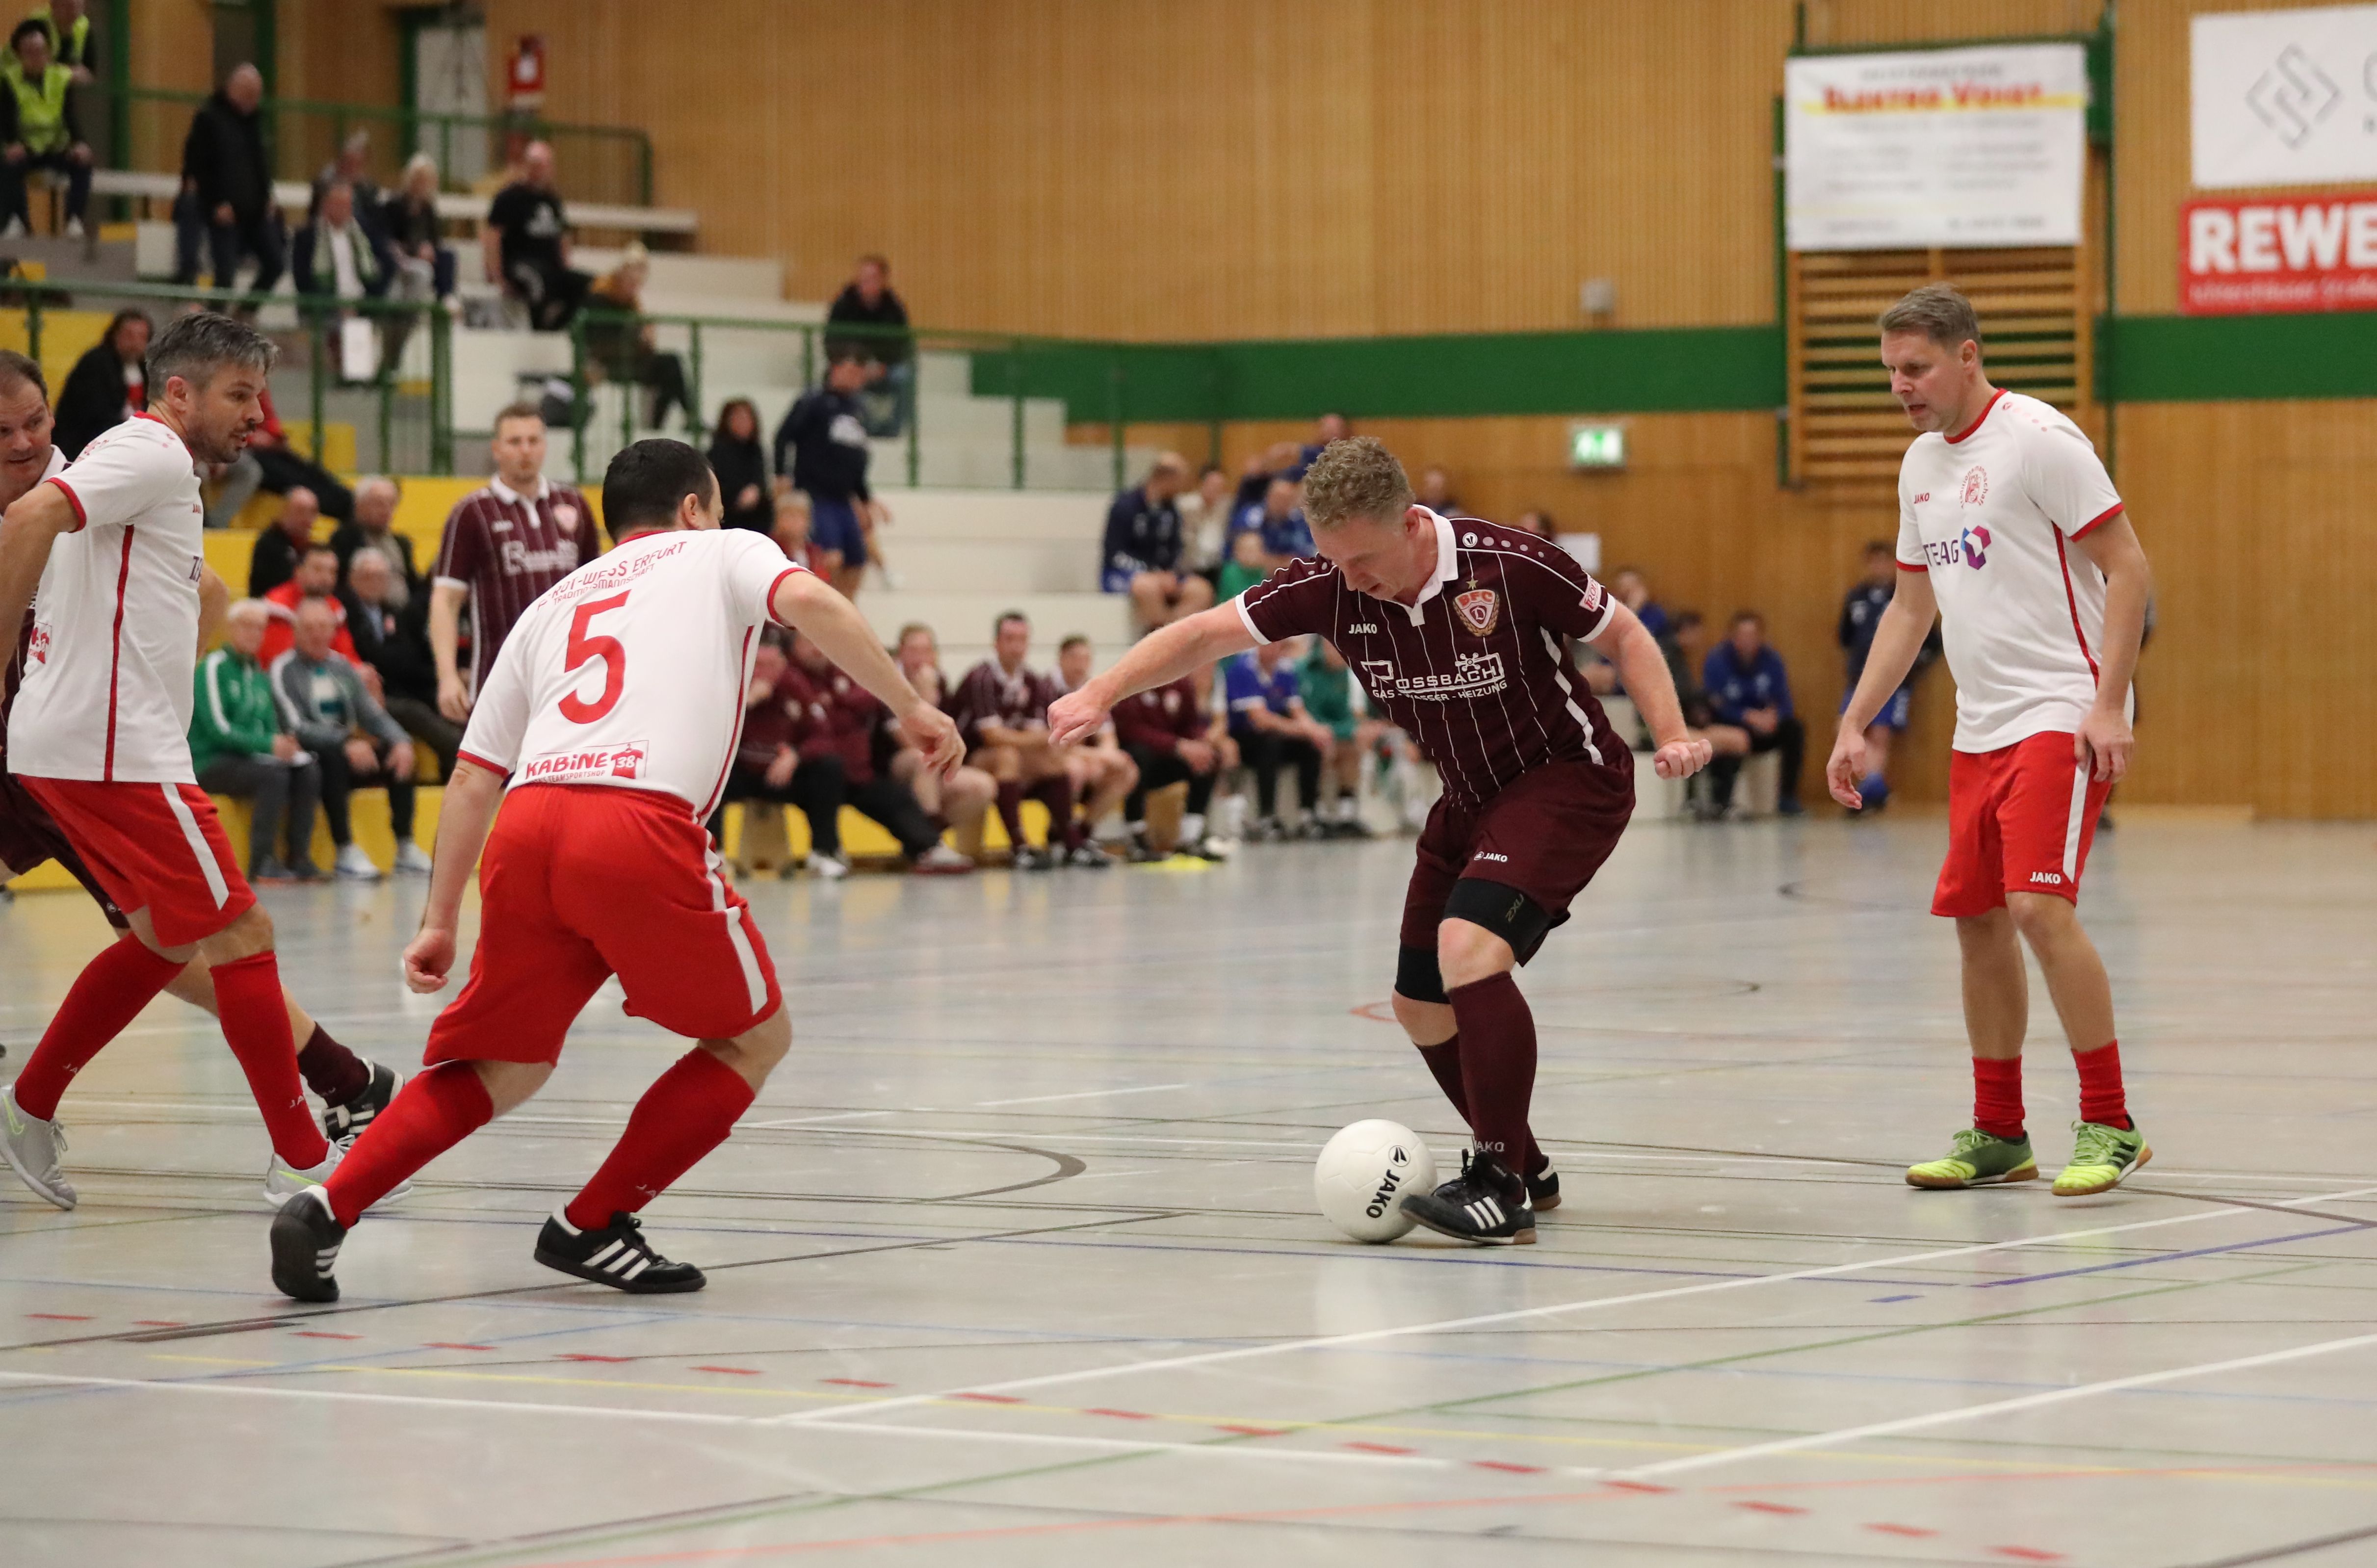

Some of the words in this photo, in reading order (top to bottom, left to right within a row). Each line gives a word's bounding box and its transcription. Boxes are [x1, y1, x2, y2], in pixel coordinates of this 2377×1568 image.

[2190, 201, 2377, 275] REWE
[632, 541, 687, 572] ERFURT
[1923, 540, 1959, 567] TEAG
[1459, 591, 1492, 607] BFC
[1349, 624, 1377, 634] JAKO
[558, 589, 631, 724] 5
[1373, 689, 1395, 699] GAS
[1459, 680, 1507, 699] HEIZUNG
[615, 756, 635, 768] 38
[1483, 853, 1508, 862] JAKO
[2030, 871, 2062, 884] JAKO
[1366, 1169, 1401, 1218] JAKO
